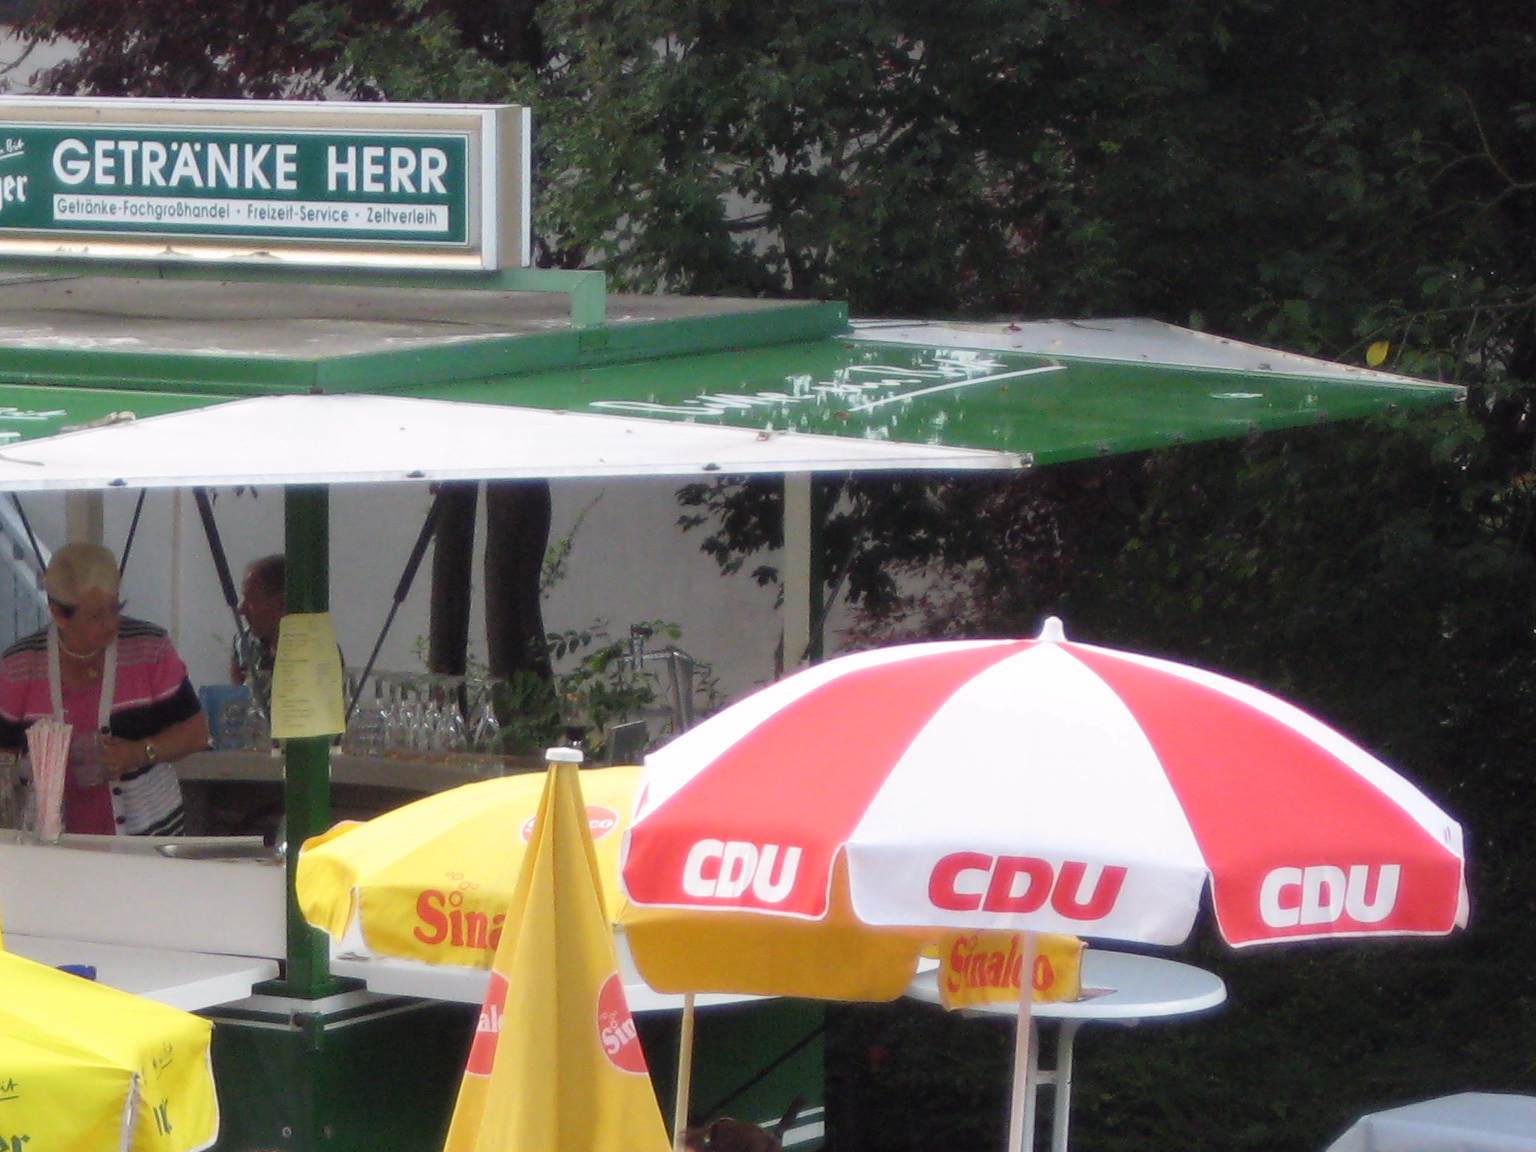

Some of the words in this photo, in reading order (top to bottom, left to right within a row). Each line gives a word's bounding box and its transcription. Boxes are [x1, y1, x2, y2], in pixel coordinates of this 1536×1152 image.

[52, 137, 298, 190] GETRÄNKE
[327, 145, 448, 194] HERR
[57, 198, 231, 219] Getränke-Fachgroßhandel
[247, 203, 349, 223] Freizeit-Service
[366, 206, 438, 225] Zeltverleih
[682, 838, 804, 904] CDU
[927, 851, 1128, 921] CDU
[1259, 863, 1402, 928] CDU
